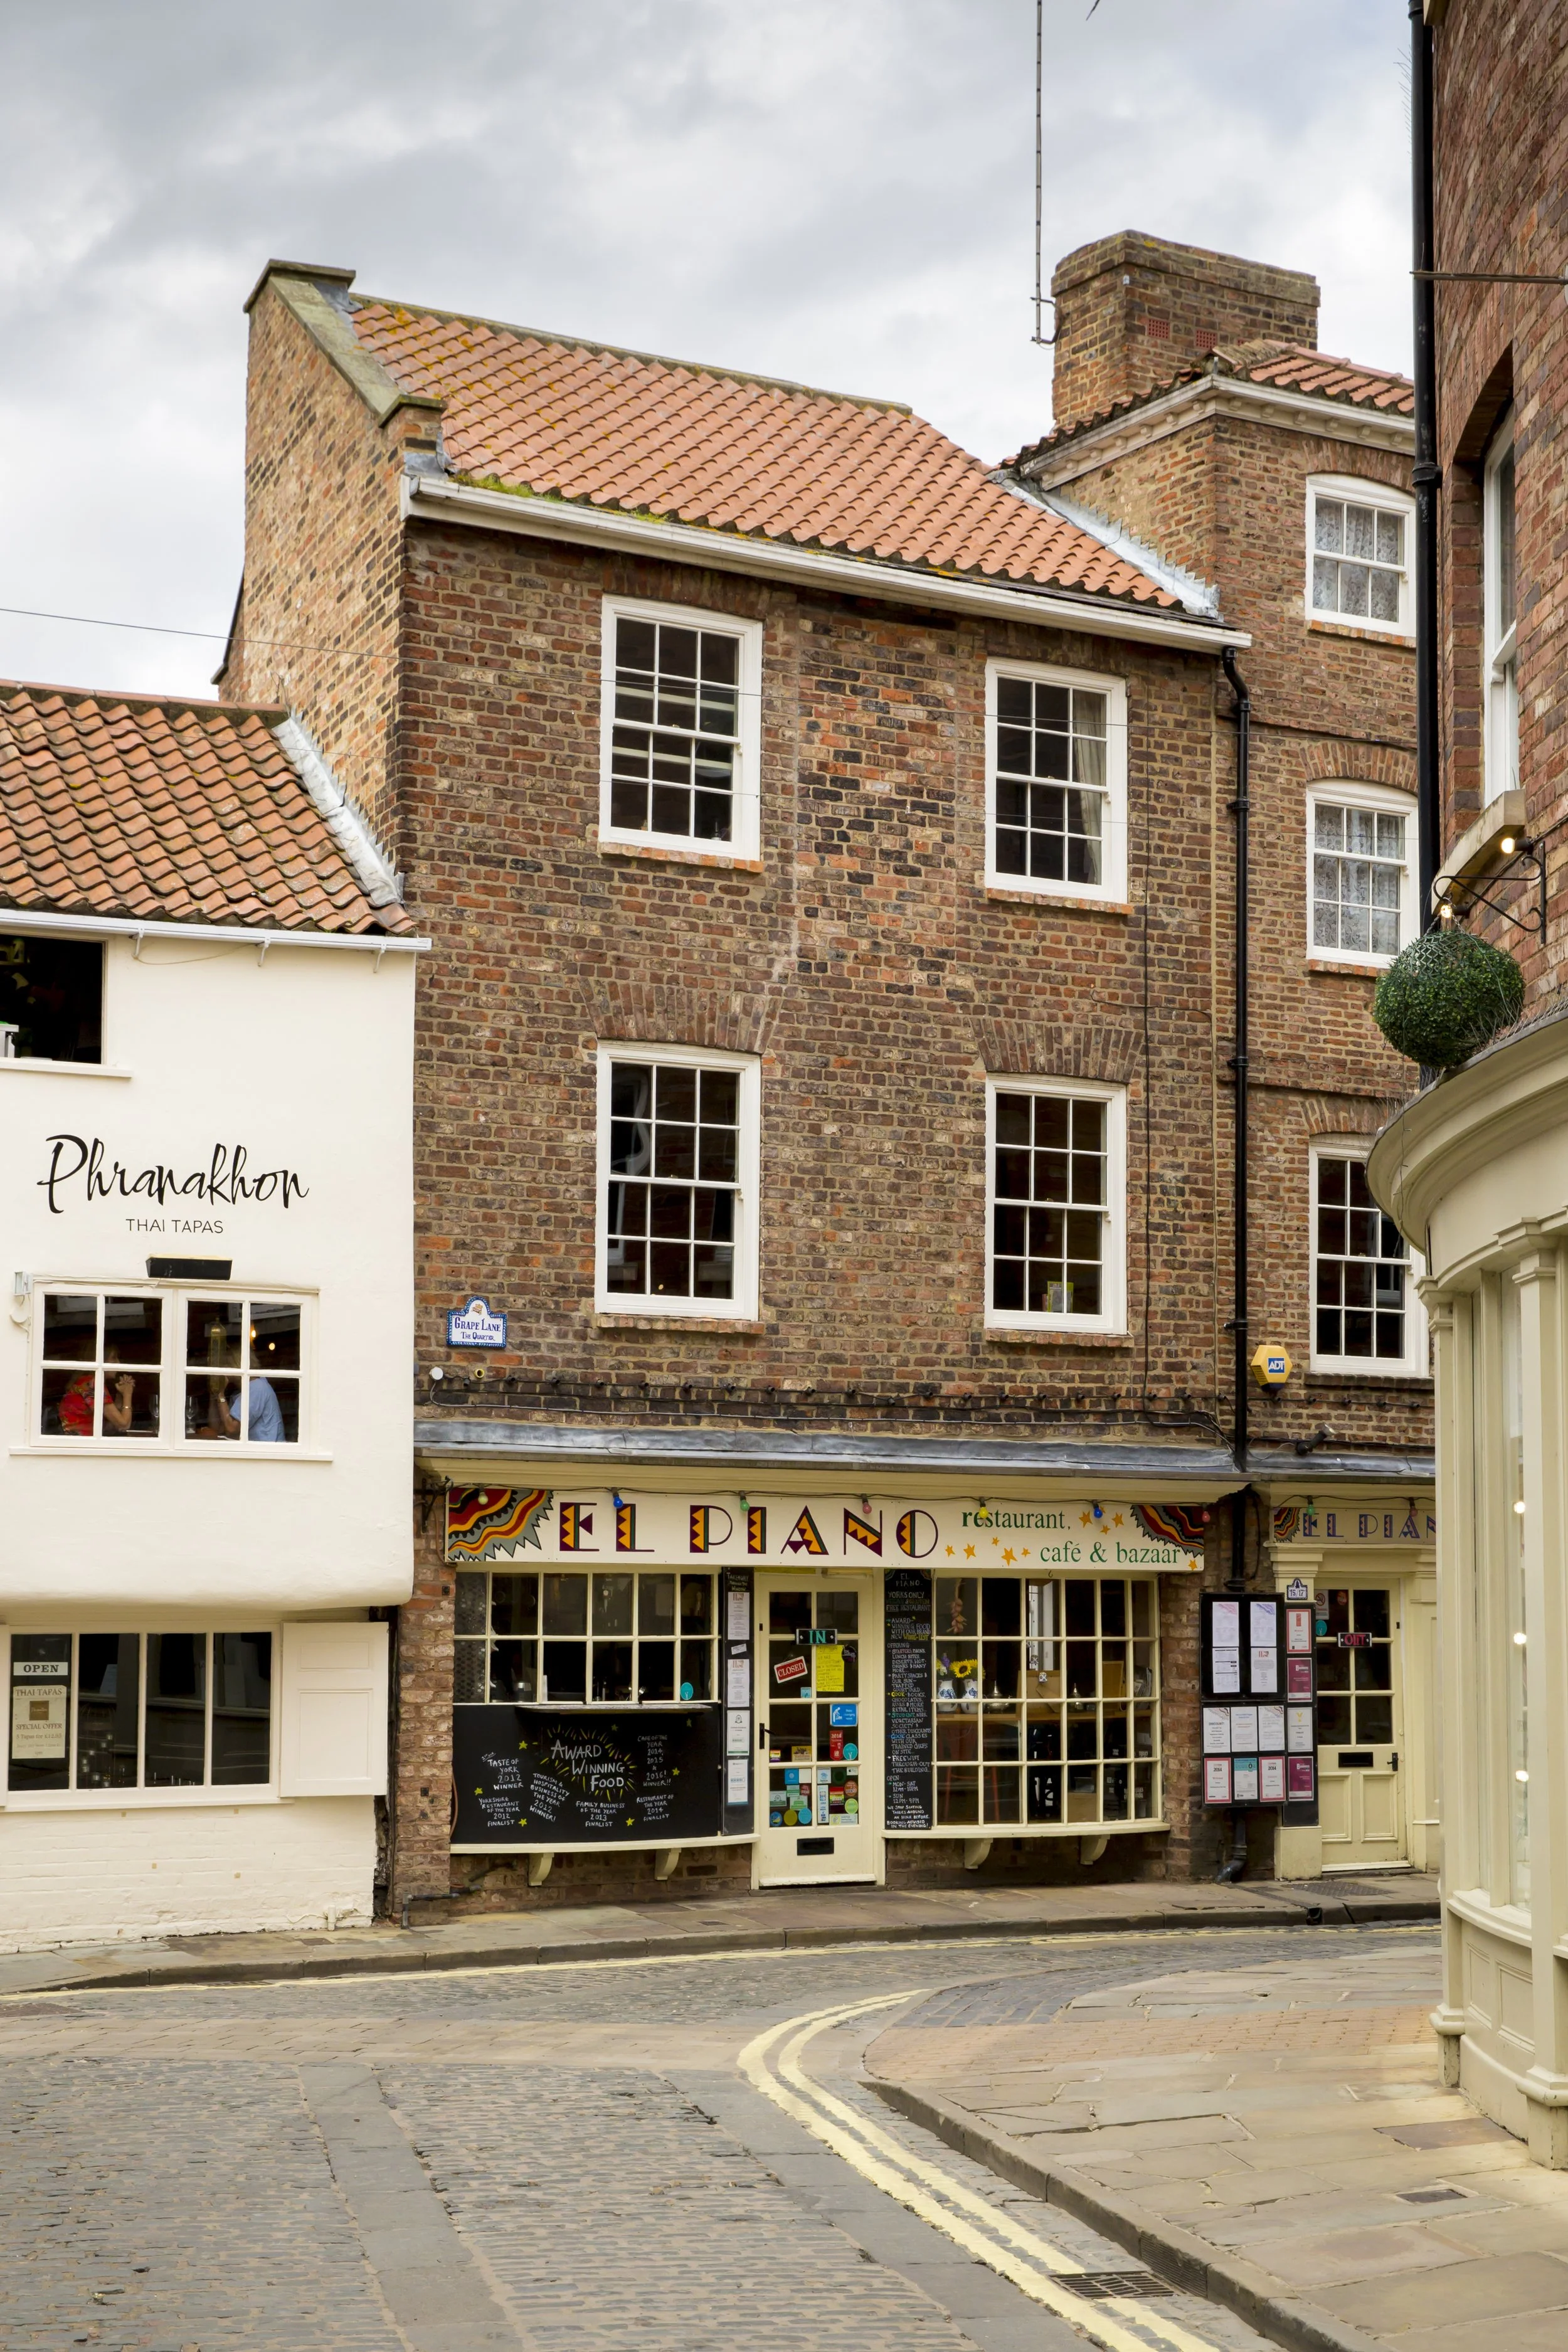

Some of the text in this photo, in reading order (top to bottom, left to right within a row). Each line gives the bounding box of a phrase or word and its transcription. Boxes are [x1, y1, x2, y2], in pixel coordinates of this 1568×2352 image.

[36, 1134, 309, 1214] Phranakhon
[126, 1219, 223, 1233] THAI TAPAS
[455, 1317, 501, 1332] GRAPE LANE
[1268, 1360, 1285, 1370] ADT
[559, 1502, 938, 1559] EL PIANO
[1303, 1513, 1343, 1537] EL
[1040, 1540, 1181, 1564] café & bazaar
[808, 1630, 827, 1644] IN
[1344, 1634, 1365, 1646] OUT
[23, 1665, 59, 1673] OPEN
[777, 1663, 804, 1677] CLOSED
[37, 1688, 63, 1696] TAPAS
[551, 1739, 602, 1759] AWARD
[487, 1759, 510, 1767] TASTE
[500, 1766, 519, 1774] YORK
[572, 1759, 625, 1775] WINNING
[497, 1774, 522, 1783] 2012
[532, 1773, 558, 1785] TOURISM
[643, 1778, 671, 1787] WINNER!!
[646, 1770, 667, 1781] 2016!
[493, 1782, 524, 1791] WINNER
[533, 1779, 570, 1797] HOSPITALITY
[590, 1774, 624, 1792] FOOD
[530, 1785, 557, 1798] BUSINESS
[636, 1794, 667, 1803] RESTAURANT
[479, 1796, 509, 1805] YORKSHIRE
[533, 1792, 561, 1808] THE YEAR
[534, 1799, 553, 1814] 2012
[529, 1805, 556, 1822] WINNER!
